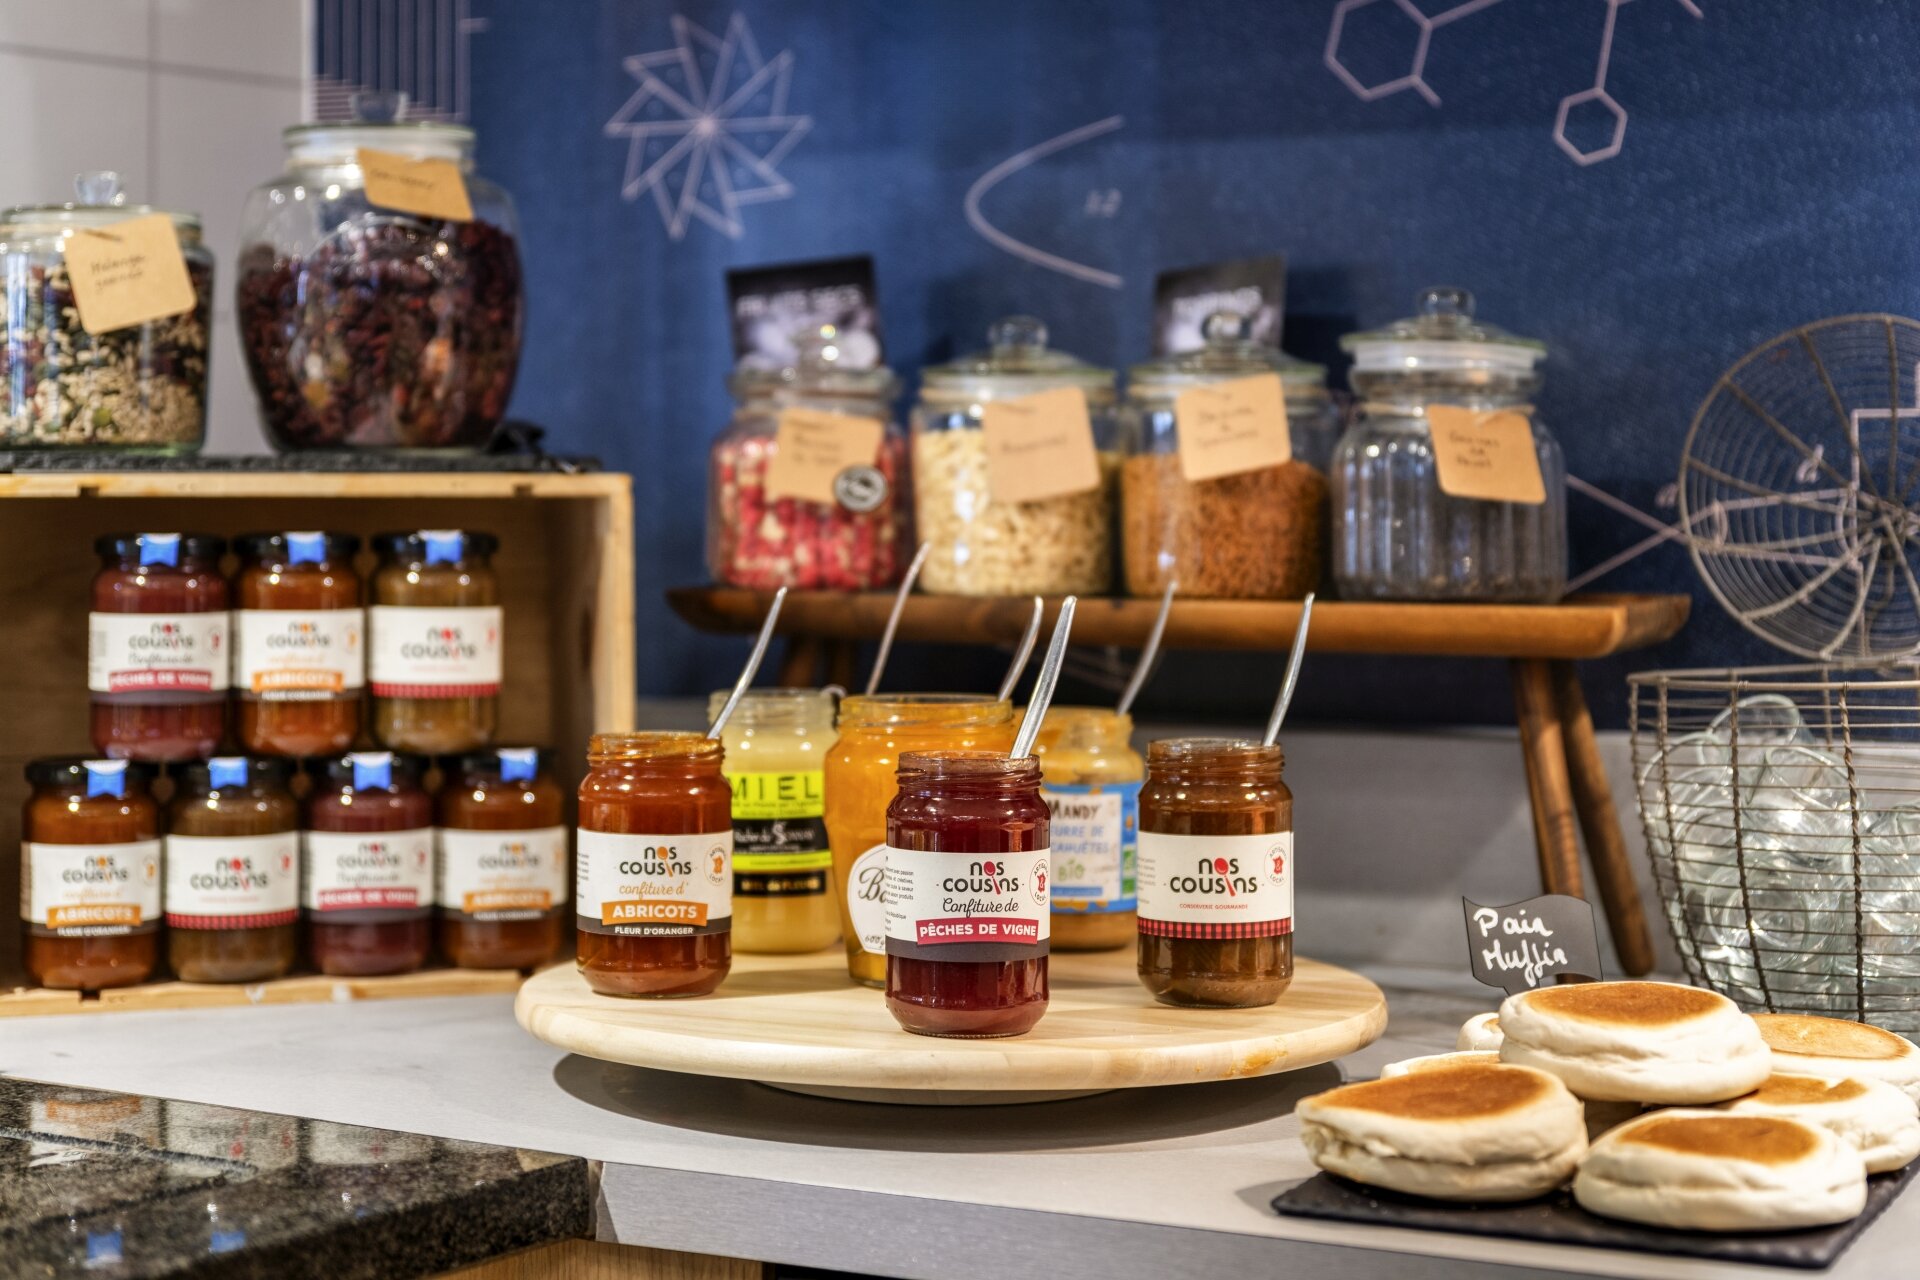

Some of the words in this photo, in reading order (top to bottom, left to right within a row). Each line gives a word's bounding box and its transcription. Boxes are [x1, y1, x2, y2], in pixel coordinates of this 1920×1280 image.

[128, 634, 194, 650] cousins
[402, 642, 476, 660] cousins
[726, 776, 819, 801] MIEL
[644, 846, 677, 860] nos
[619, 860, 692, 877] cousins
[970, 861, 1004, 876] nos
[1198, 858, 1239, 875] nos
[62, 868, 129, 884] cousins
[190, 873, 268, 890] cousins
[618, 881, 674, 900] confiture
[943, 876, 1019, 894] cousins
[1170, 875, 1258, 897] cousins
[612, 904, 698, 919] ABRICOTS
[943, 897, 1003, 917] Confiture
[1003, 900, 1019, 912] de
[920, 923, 974, 938] PÊCHES
[978, 924, 998, 935] DE
[1002, 924, 1037, 937] VIGNE
[1473, 907, 1554, 937] Pain
[614, 926, 641, 935] FLEUR
[643, 926, 694, 936] D'ORANGER
